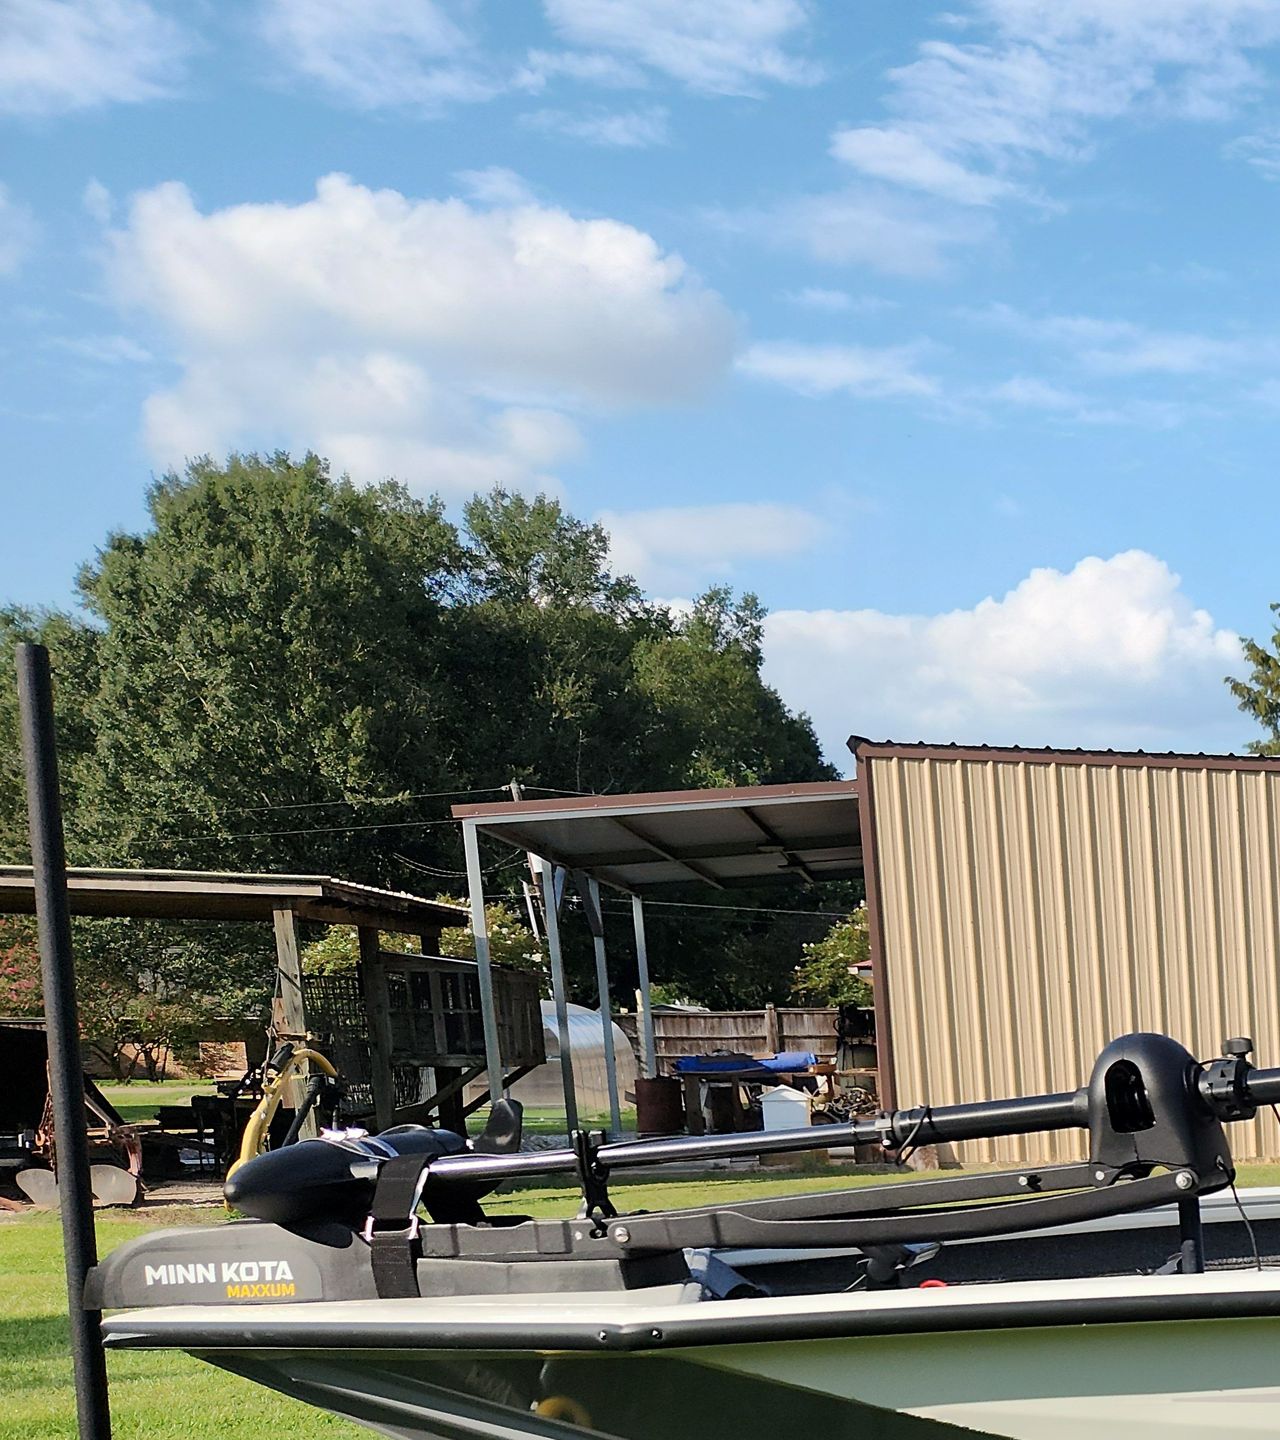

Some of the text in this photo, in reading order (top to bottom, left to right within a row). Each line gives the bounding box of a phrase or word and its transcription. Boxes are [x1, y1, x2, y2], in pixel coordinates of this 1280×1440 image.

[144, 1260, 295, 1286] MINN KOTA
[226, 1283, 296, 1299] MAXXUM
